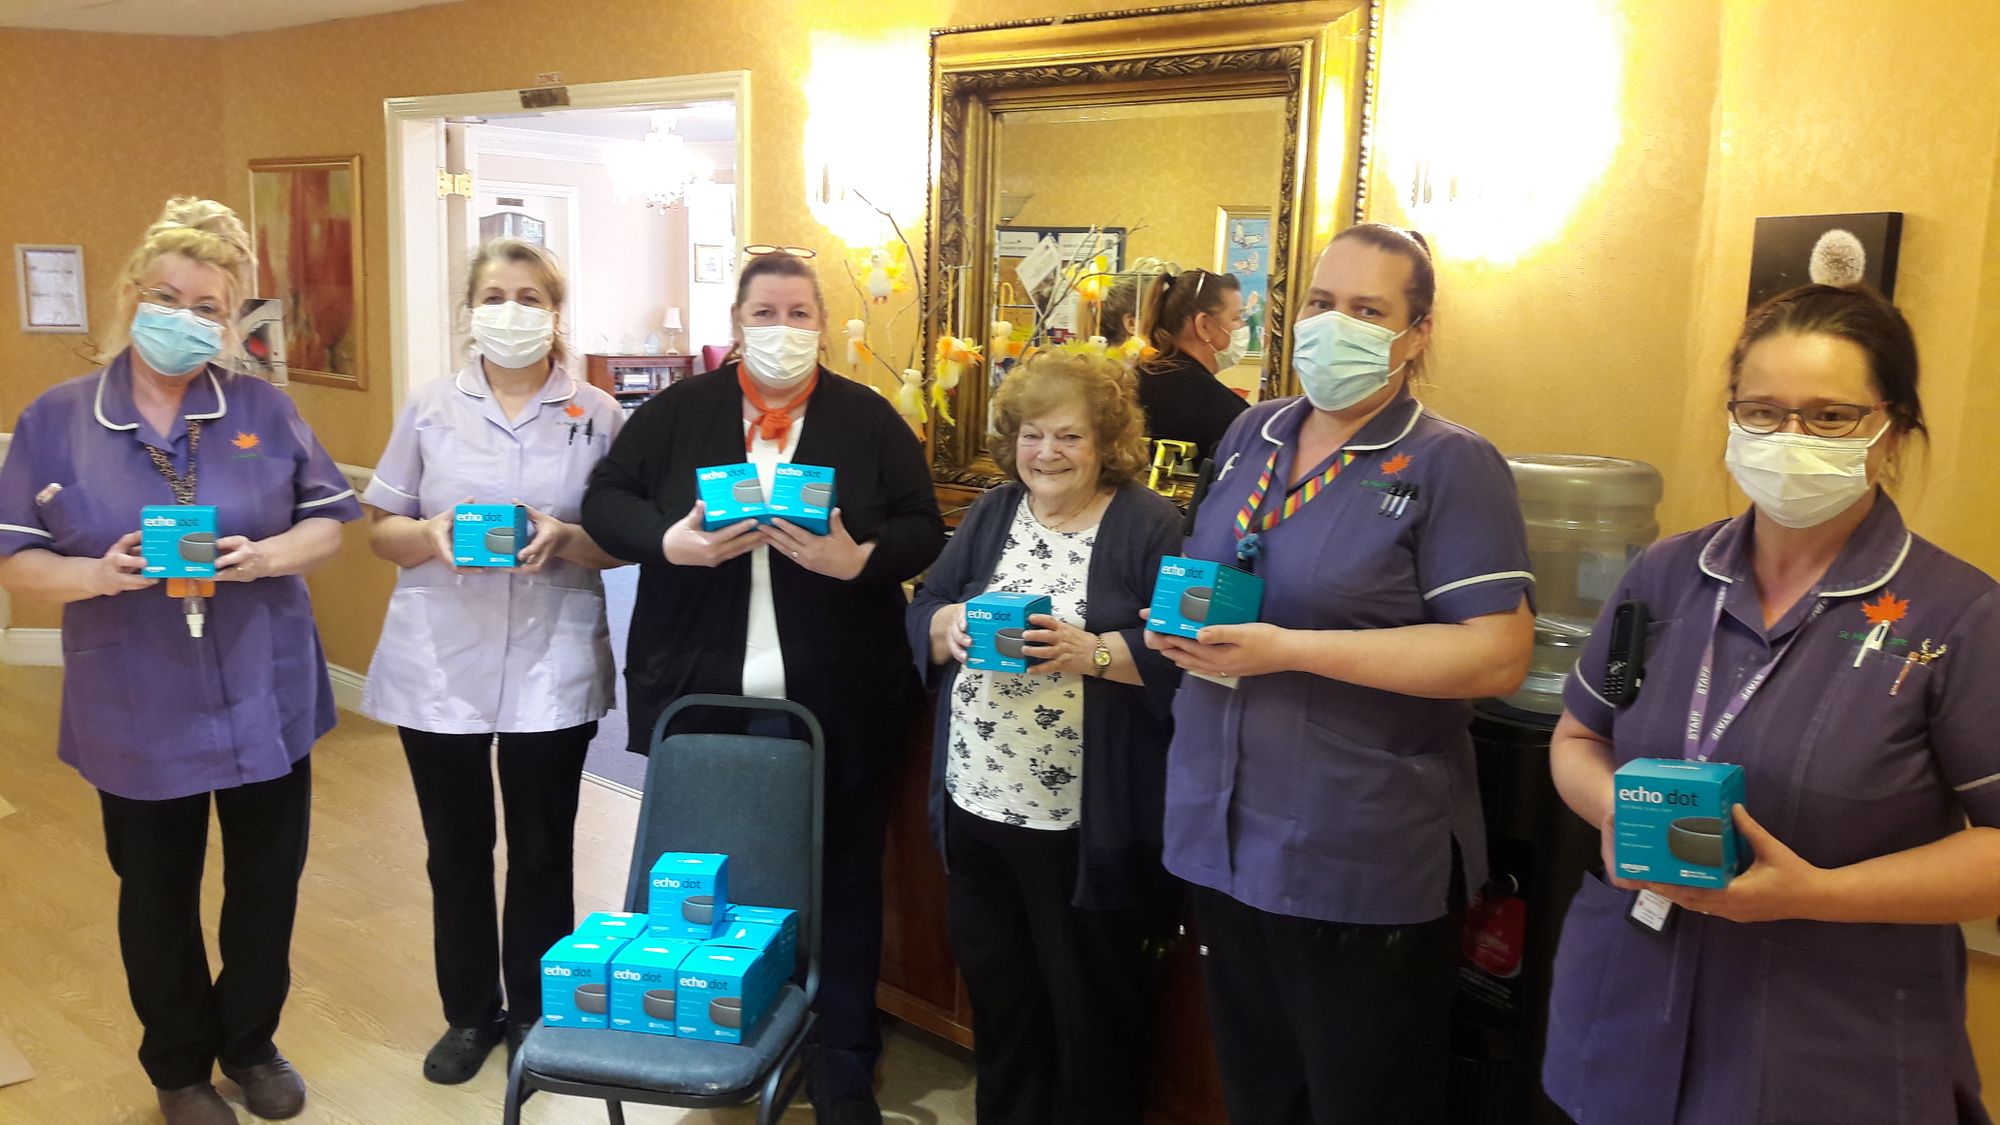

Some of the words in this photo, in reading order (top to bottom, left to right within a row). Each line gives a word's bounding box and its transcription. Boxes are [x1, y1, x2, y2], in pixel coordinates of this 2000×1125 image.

[456, 512, 483, 522] echo
[485, 512, 503, 522] dot
[967, 609, 993, 620] echo
[993, 610, 1012, 622] dot
[1696, 666, 1712, 695] STAFF
[1741, 674, 1765, 701] STAFF
[1687, 710, 1702, 740] STAFF
[1711, 712, 1735, 741] STAFF
[1619, 786, 1663, 804] echo
[1667, 787, 1699, 807] dot
[653, 877, 681, 888] echo
[682, 878, 702, 889] dot
[544, 965, 571, 976] echo
[572, 966, 592, 978] dot
[613, 969, 641, 981] echo
[642, 970, 662, 983] dot
[679, 976, 707, 989] echo
[709, 978, 729, 991] dot
